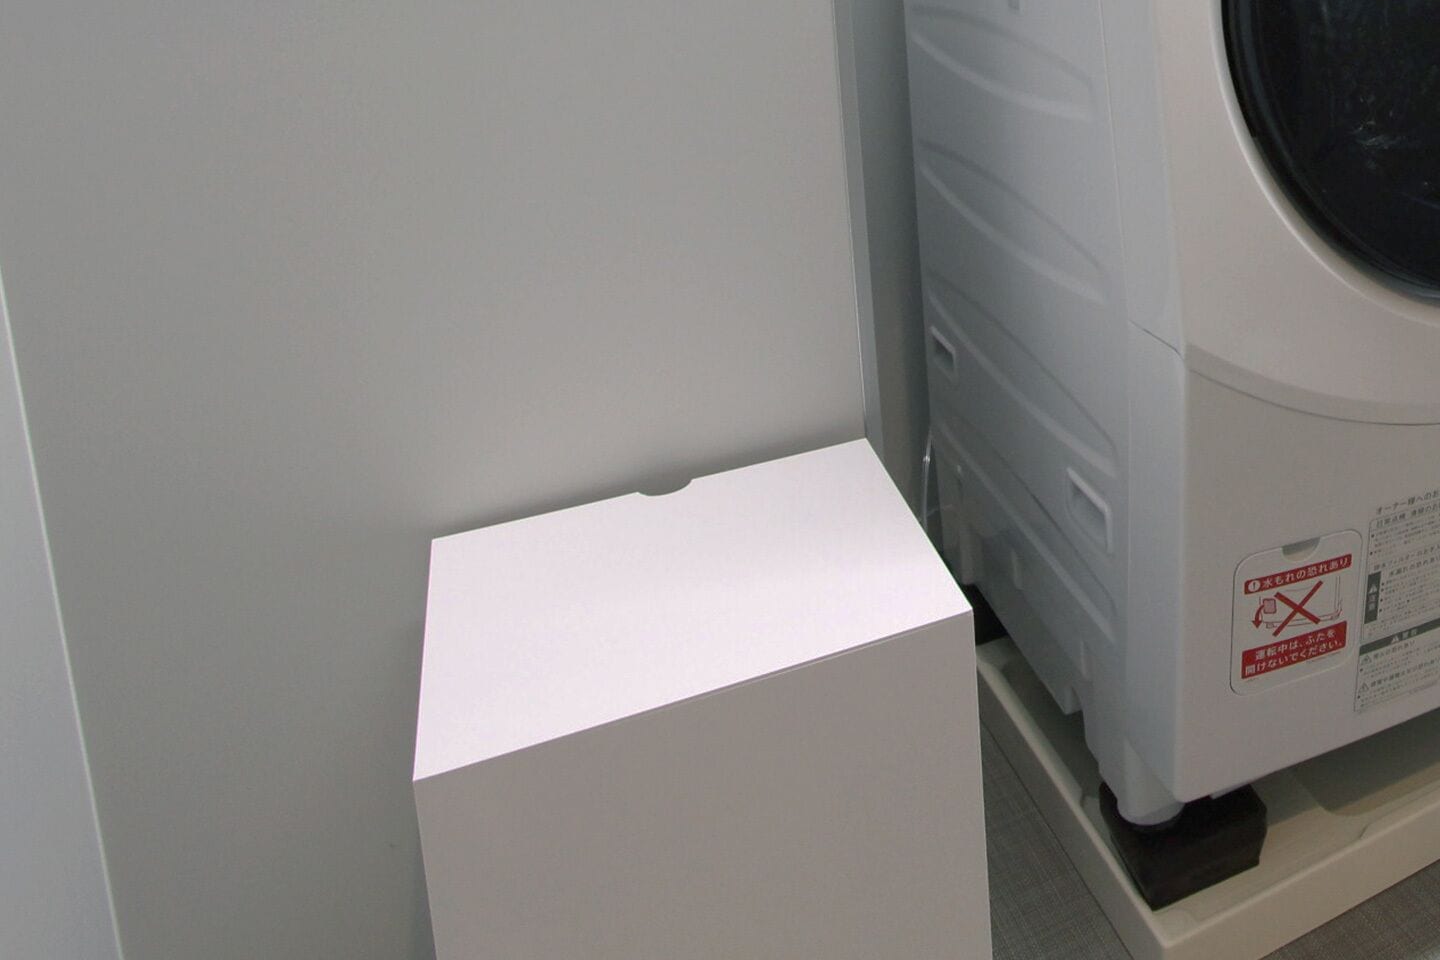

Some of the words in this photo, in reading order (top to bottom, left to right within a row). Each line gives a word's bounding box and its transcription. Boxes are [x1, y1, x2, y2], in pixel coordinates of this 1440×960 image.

[1262, 557, 1348, 589] 水もれの恐れあり
[1245, 640, 1342, 677] 開けないでください。
[1255, 629, 1335, 660] 運転中は、ふたを
